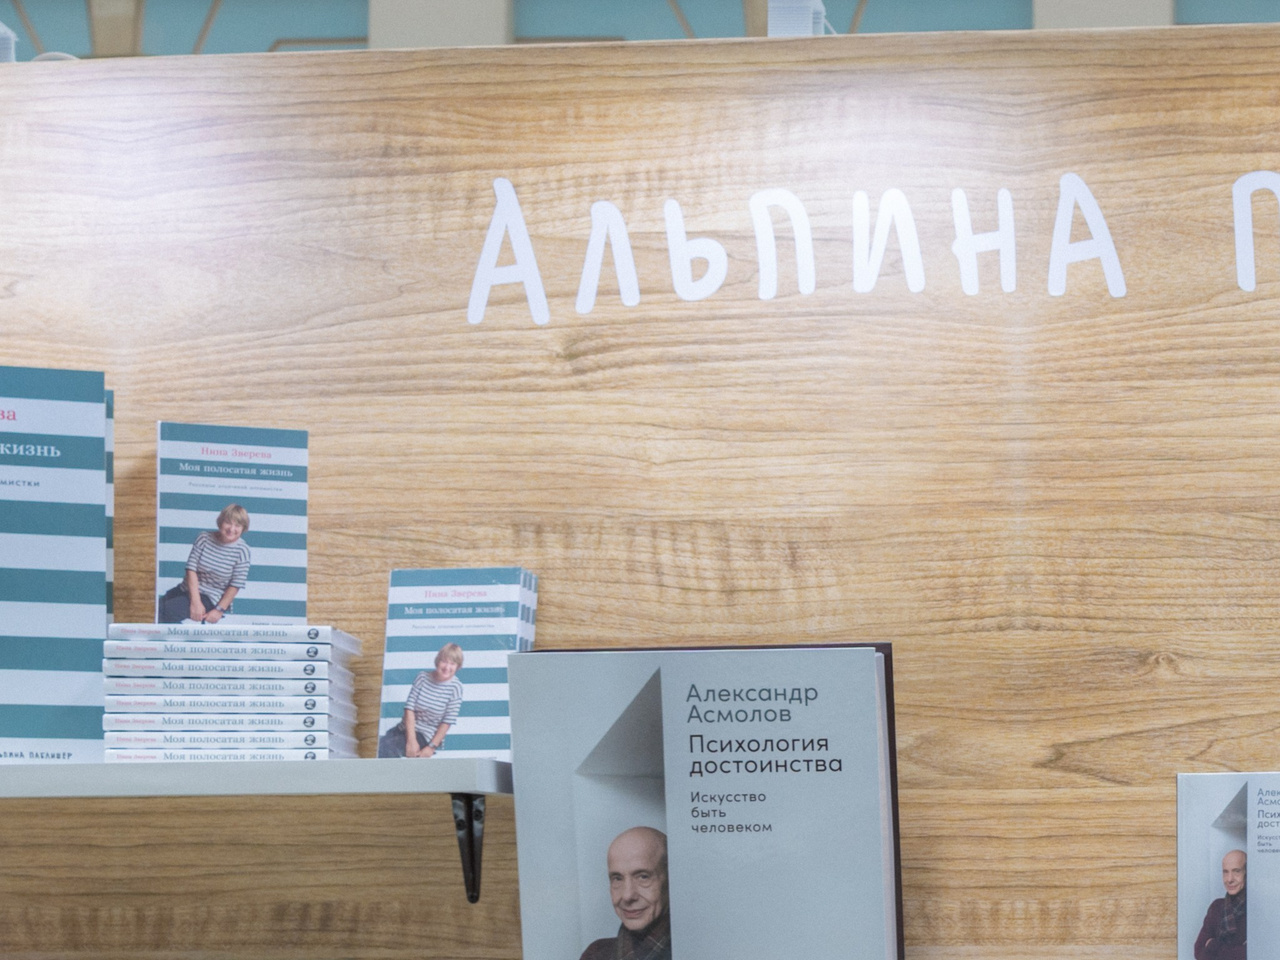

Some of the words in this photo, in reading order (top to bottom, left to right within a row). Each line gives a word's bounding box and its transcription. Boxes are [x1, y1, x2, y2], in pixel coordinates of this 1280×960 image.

[467, 173, 1127, 325] АЛЬПИНА
[201, 447, 228, 457] Нина
[231, 449, 272, 459] Зверева
[179, 462, 201, 472] Моя
[203, 465, 257, 476] полосатая
[260, 469, 293, 477] жизнь
[167, 627, 190, 636] Моя
[193, 627, 248, 637] полосатая
[252, 629, 288, 637] жизнь
[686, 683, 818, 706] Александр
[686, 704, 792, 724] Асмолов
[689, 735, 829, 753] Психология
[689, 757, 843, 777] достоинства
[690, 791, 767, 804] Искусство
[690, 806, 727, 818] быть
[691, 822, 772, 833] человеком
